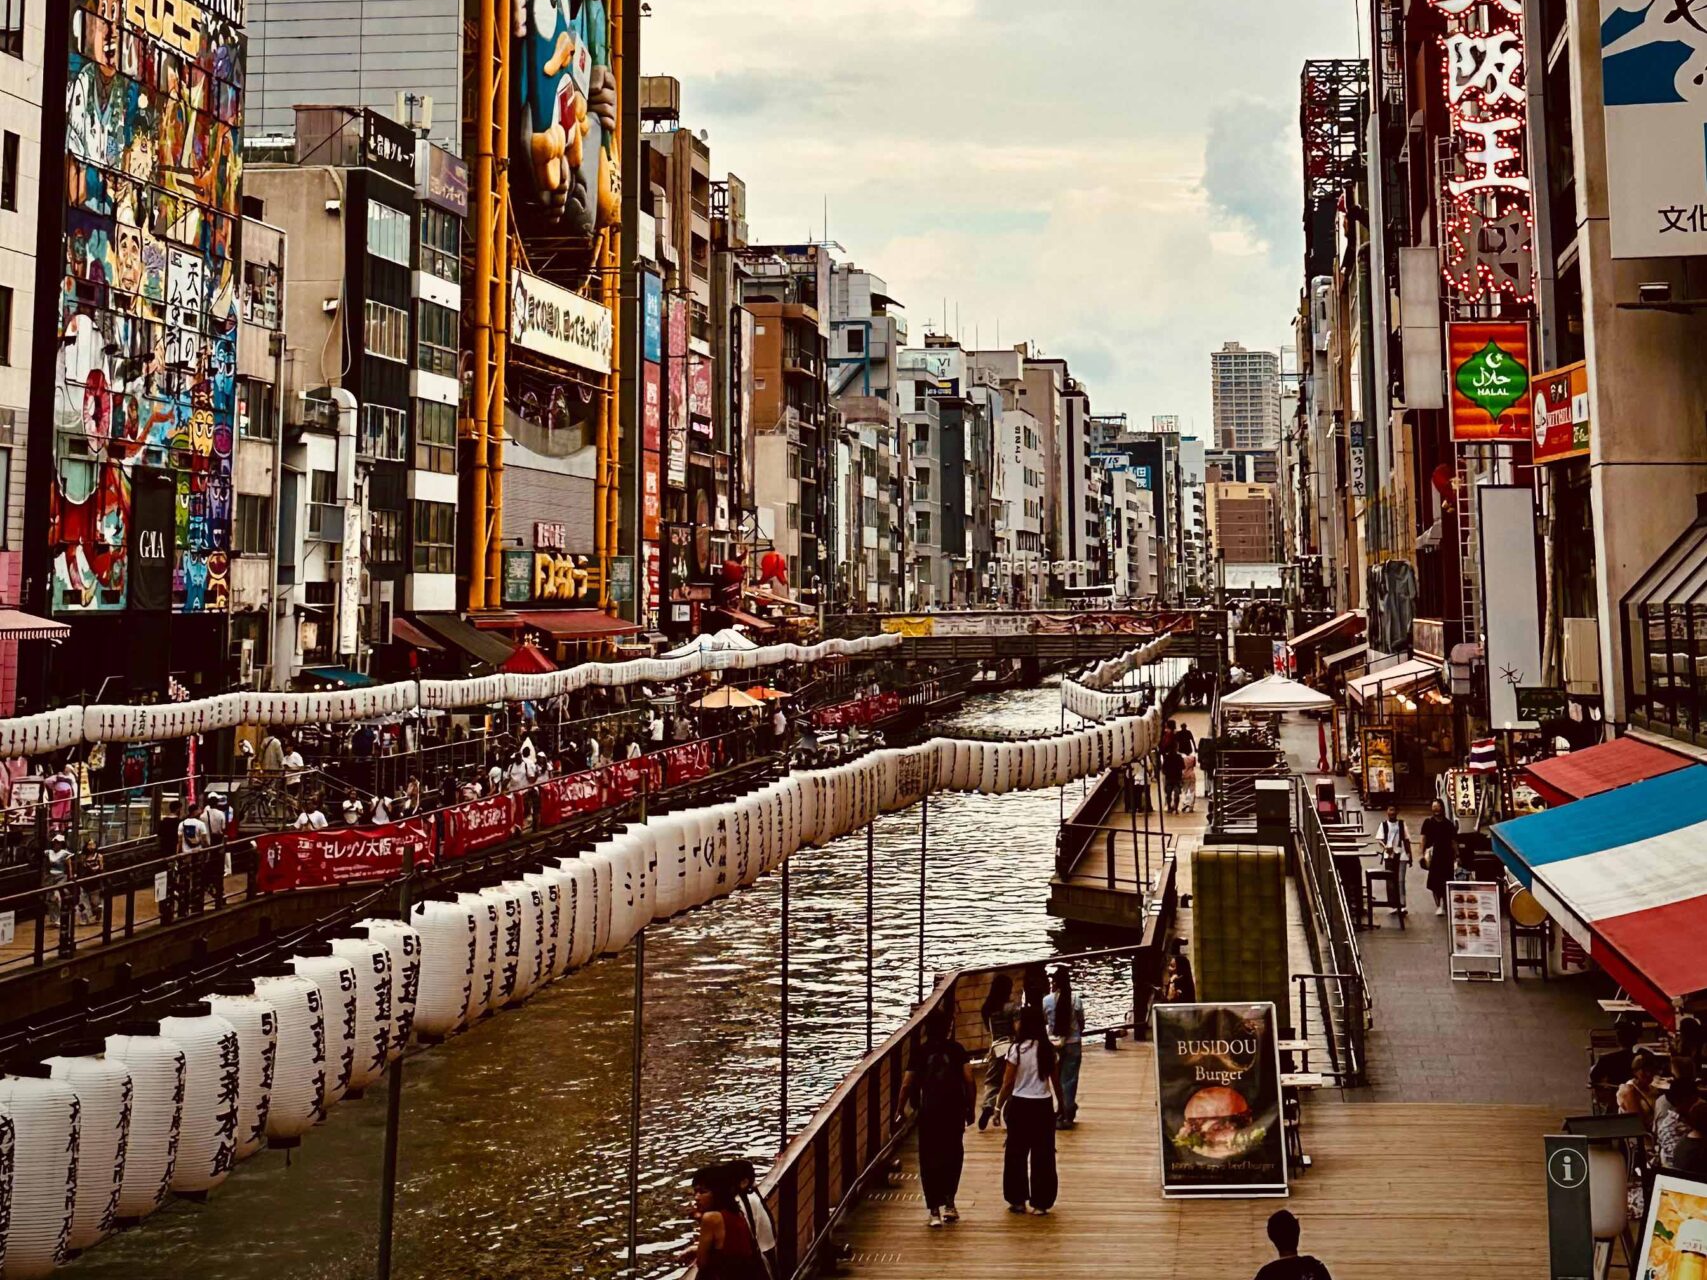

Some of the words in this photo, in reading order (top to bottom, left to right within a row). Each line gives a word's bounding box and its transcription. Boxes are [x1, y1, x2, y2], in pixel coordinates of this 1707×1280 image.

[1472, 366, 1512, 388] حلال
[1477, 388, 1510, 396] HALAL
[1177, 1039, 1257, 1056] BUSIDOU
[1195, 1066, 1243, 1085] Burger
